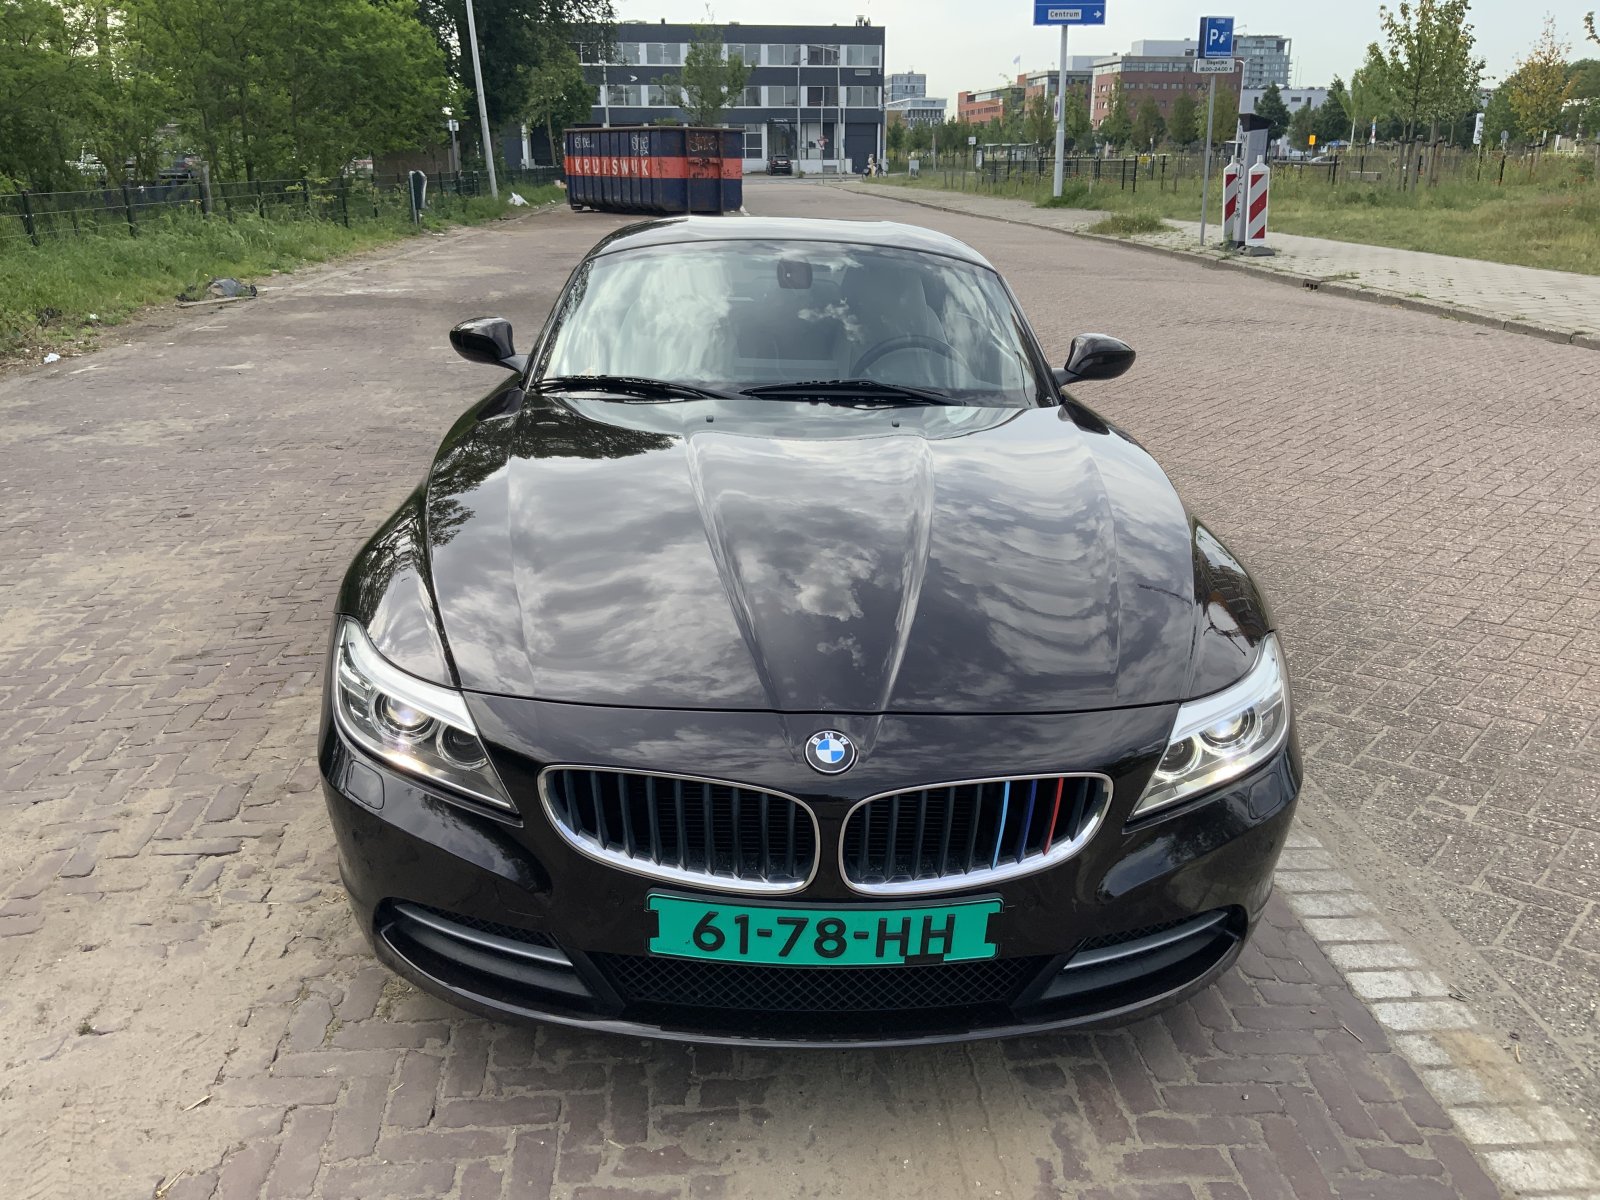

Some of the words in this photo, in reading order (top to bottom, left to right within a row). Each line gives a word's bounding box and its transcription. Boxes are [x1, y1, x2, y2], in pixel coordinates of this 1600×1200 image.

[1209, 28, 1219, 46] P
[811, 732, 849, 746] BMW
[692, 911, 956, 958] 61-78-HH
